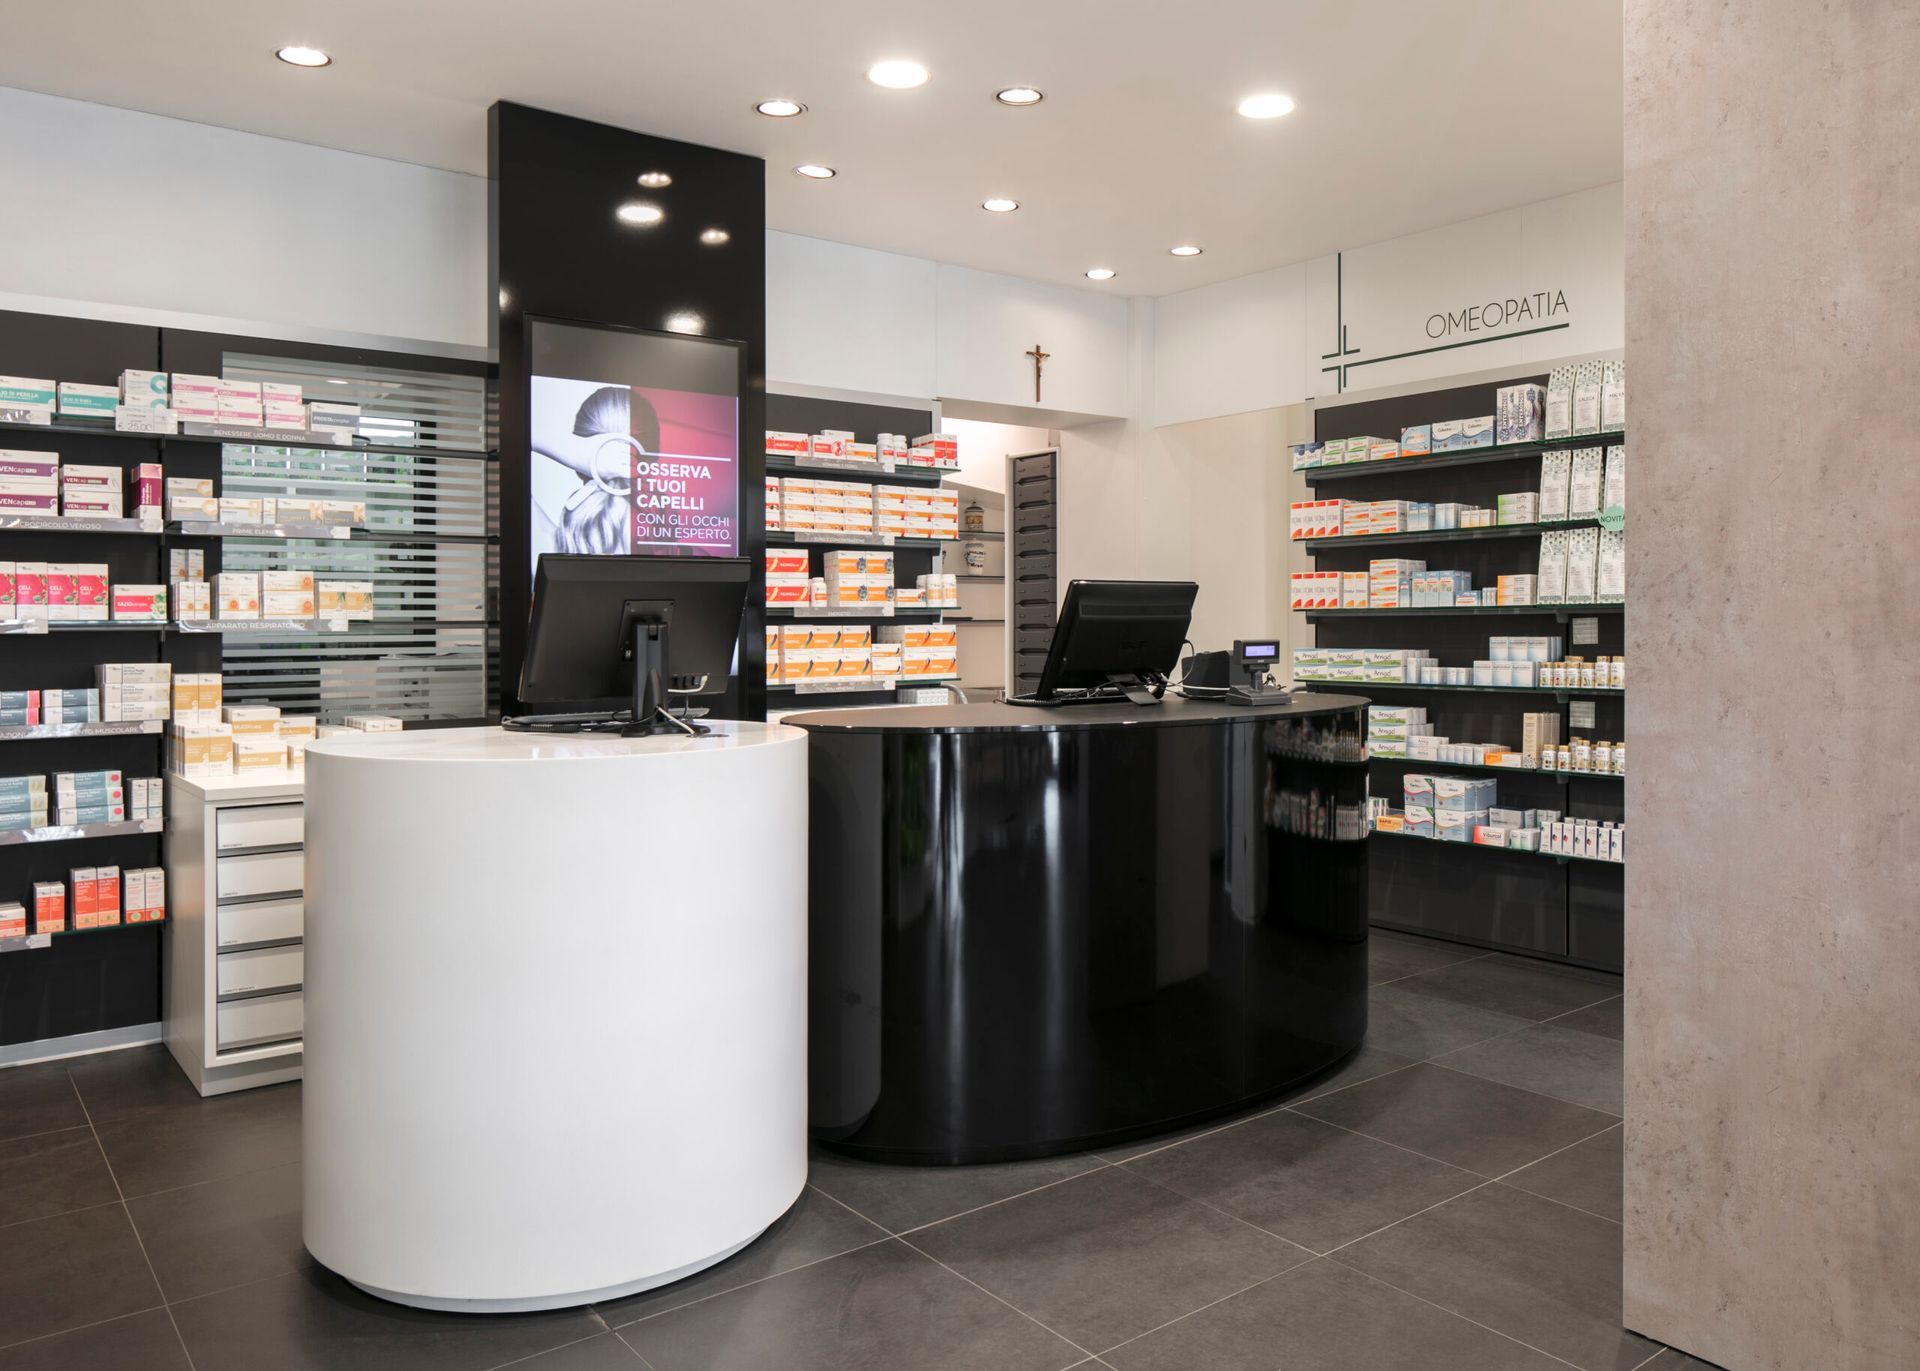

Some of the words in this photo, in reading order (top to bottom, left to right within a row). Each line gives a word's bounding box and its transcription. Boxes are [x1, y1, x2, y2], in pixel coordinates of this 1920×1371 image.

[1426, 288, 1569, 338] OMEOPATIA
[214, 430, 252, 438] BENESSERE
[637, 462, 711, 480] OSSERVA
[637, 478, 641, 491] I
[646, 479, 686, 494] TUOI
[637, 494, 704, 510] CAPELLI
[637, 513, 665, 525] CON
[669, 515, 688, 526] GLI
[692, 515, 729, 527] OCCHI
[637, 526, 650, 537] DI
[652, 528, 671, 538] UN
[675, 528, 732, 540] ESPERTO.
